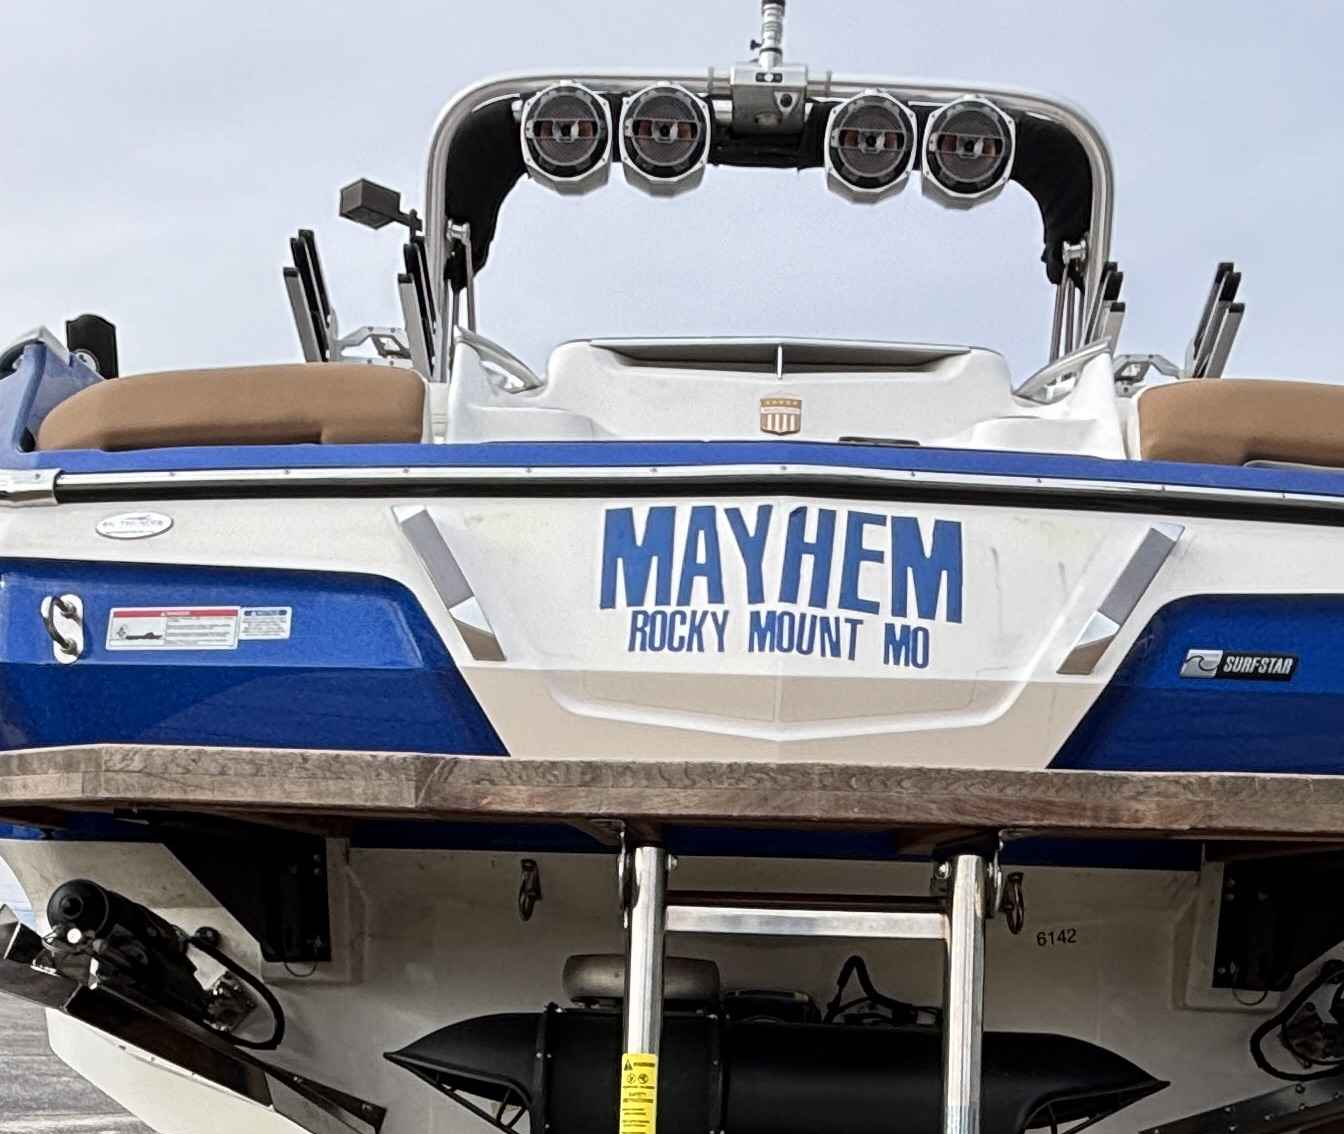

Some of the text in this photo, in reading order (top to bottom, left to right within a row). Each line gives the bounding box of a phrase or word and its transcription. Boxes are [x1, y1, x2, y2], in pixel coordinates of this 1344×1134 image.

[600, 504, 963, 624] MAYHEM
[628, 610, 931, 669] ROCKY MOUNT MO
[1223, 656, 1293, 674] SURFSTAR
[1036, 927, 1077, 946] 6142
